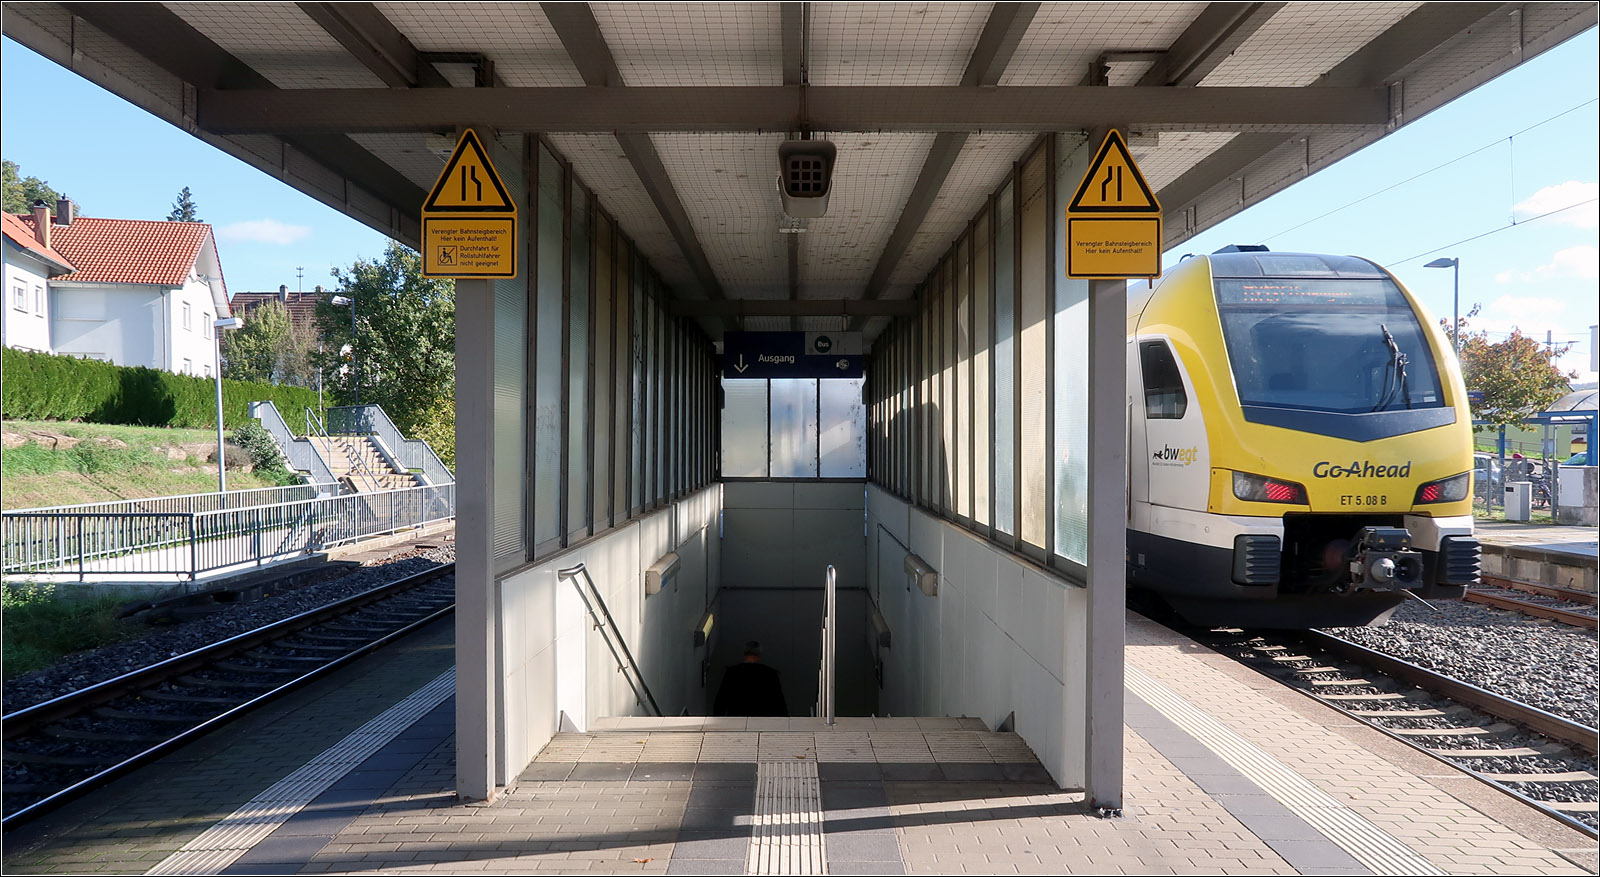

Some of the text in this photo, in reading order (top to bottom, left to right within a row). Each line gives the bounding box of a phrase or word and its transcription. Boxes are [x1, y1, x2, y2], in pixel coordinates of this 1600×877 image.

[459, 228, 507, 236] Bahnsteigbereich
[758, 354, 795, 364] Ausgang
[1164, 444, 1198, 465] bwegt
[1340, 495, 1387, 506] ET 5.08 B
